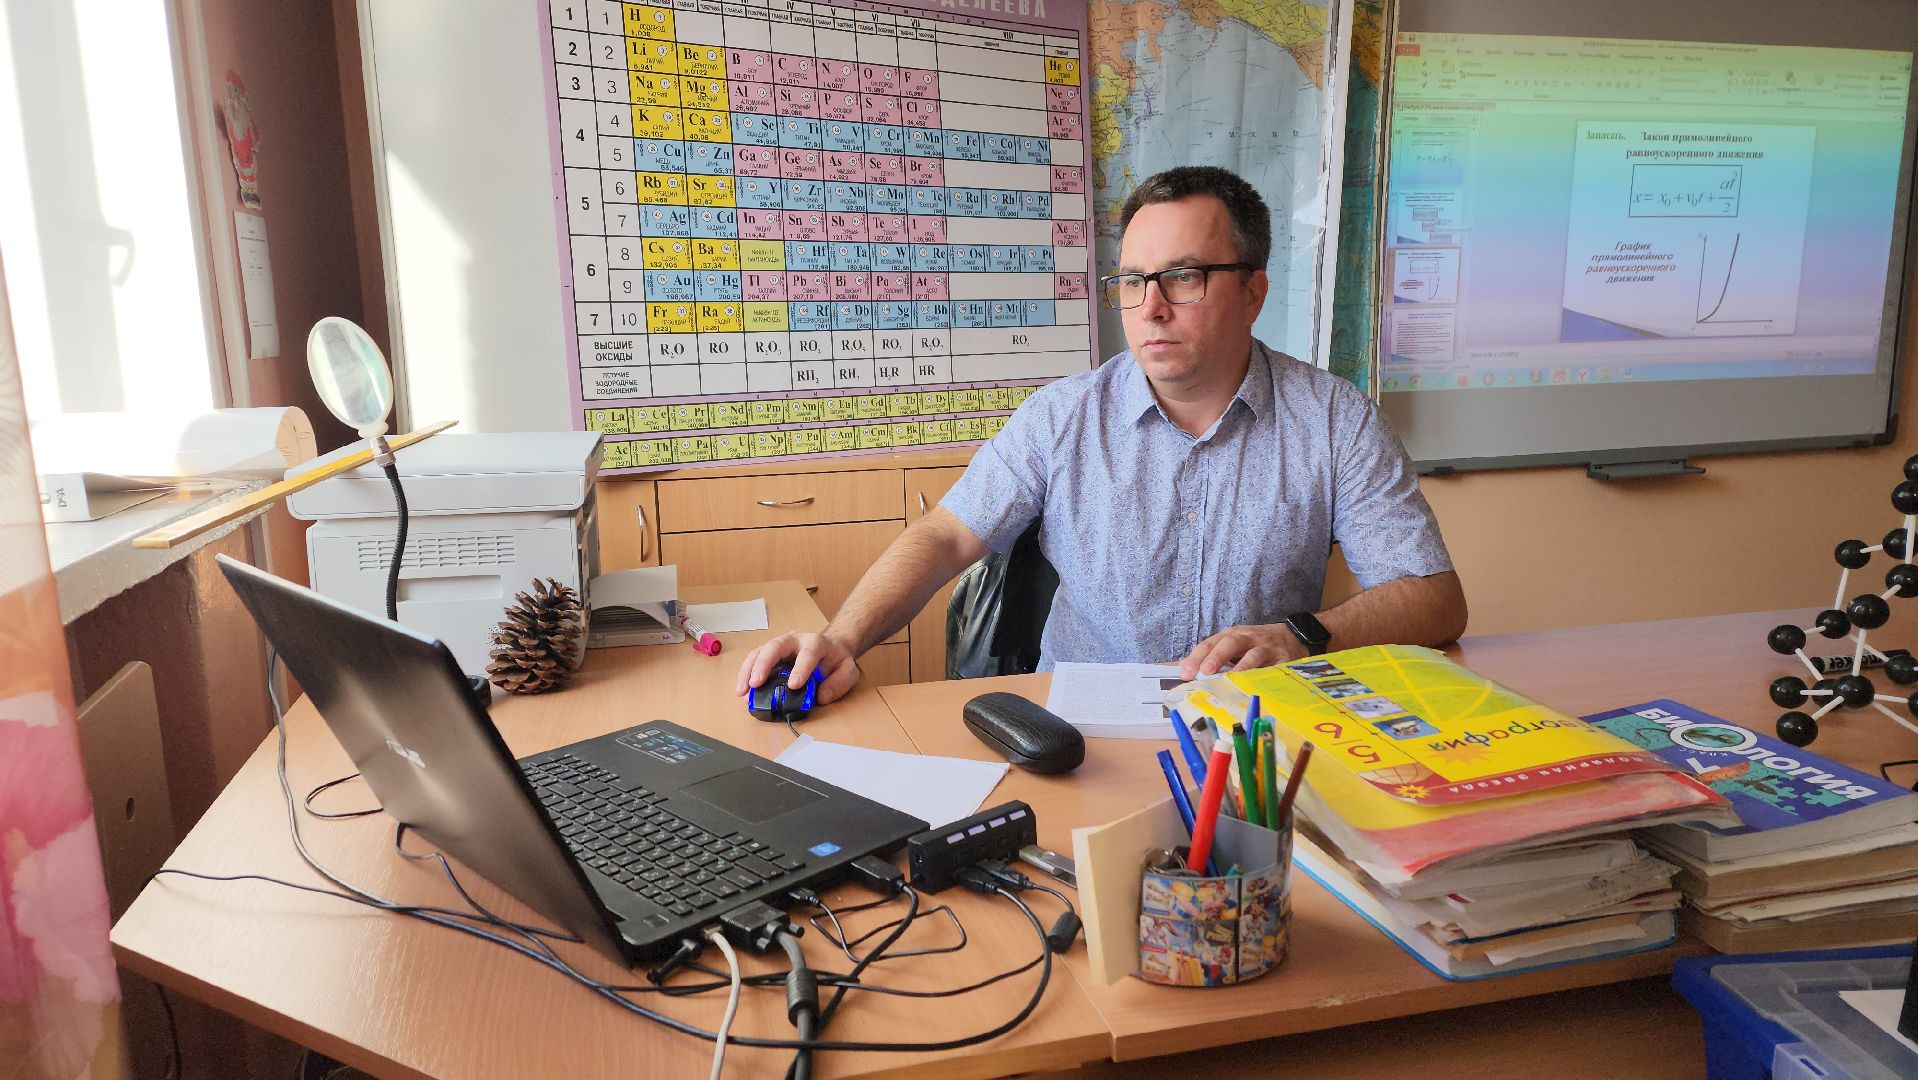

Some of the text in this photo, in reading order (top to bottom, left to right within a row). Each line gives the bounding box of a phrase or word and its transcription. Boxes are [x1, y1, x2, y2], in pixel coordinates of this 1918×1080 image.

[566, 7, 573, 20] 1
[603, 12, 609, 25] 1
[630, 8, 641, 21] H
[569, 42, 578, 56] 2
[605, 46, 614, 60] 2
[632, 42, 646, 56] Li
[683, 47, 699, 61] Be
[732, 53, 741, 65] B
[778, 57, 787, 70] C
[822, 62, 831, 75] N
[1049, 60, 1062, 71] He
[864, 68, 873, 79] O
[905, 71, 911, 82] F
[572, 76, 581, 91] 3
[608, 81, 617, 94] 3
[635, 75, 653, 90] Na
[686, 80, 706, 98] Mg
[735, 86, 748, 98] Al
[781, 89, 791, 101] Si
[1050, 88, 1063, 98] Ne
[824, 93, 831, 105] P
[866, 97, 873, 109] S
[906, 101, 918, 113] Cl
[611, 115, 620, 128] 4
[639, 109, 650, 122] K
[689, 113, 706, 126] Ca
[1052, 115, 1063, 126] Ar
[761, 119, 774, 130] Sc
[807, 122, 819, 134] Ti
[576, 129, 585, 142] 4
[852, 126, 860, 137] V
[887, 129, 901, 141] Cr
[923, 132, 940, 144] Mn
[966, 135, 978, 147] Fe
[1000, 137, 1013, 149] Co
[1641, 131, 1670, 142] Закон
[1672, 133, 1753, 145] прямолинейного
[613, 148, 622, 162] 5
[663, 144, 681, 157] Cu
[713, 147, 730, 160] Zn
[739, 149, 756, 161] Ga
[1626, 148, 1714, 160] равноускоренного
[785, 152, 800, 165] Ge
[829, 155, 842, 167] As
[869, 157, 881, 169] Se
[910, 160, 922, 172] Br
[1055, 169, 1067, 180] Kr
[615, 181, 625, 195] 6
[643, 176, 662, 189] Rb
[692, 178, 707, 190] Sr
[769, 182, 777, 194] Y
[808, 184, 822, 196] Zr
[849, 187, 863, 199] Nb
[887, 188, 904, 200] Mo
[931, 191, 943, 201] Tc
[581, 197, 590, 210] 5
[966, 192, 979, 204] Ru
[1002, 194, 1015, 204] Rh
[1038, 195, 1050, 206] Pd
[617, 215, 627, 228] 7
[669, 210, 686, 225] Ag
[716, 212, 734, 224] Cd
[743, 212, 756, 224] In
[788, 214, 803, 226] Sn
[831, 215, 845, 227] Sb
[873, 217, 885, 229] Te
[1056, 223, 1068, 233] Xe
[648, 242, 665, 254] Cs
[698, 243, 714, 255] Ba
[812, 246, 827, 257] Hf
[856, 246, 868, 258] Ta
[1615, 241, 1651, 251] График
[621, 248, 630, 261] 8
[895, 247, 907, 258] W
[933, 248, 946, 259] Re
[969, 248, 982, 259] Os
[1009, 249, 1018, 259] Ir
[1591, 252, 1673, 262] прямолинейного
[587, 263, 596, 277] 6
[1586, 264, 1676, 275] равноускоренного
[673, 275, 691, 286] Au
[721, 275, 738, 289] Hg
[748, 275, 760, 287] Tl
[792, 275, 807, 287] Pb
[835, 275, 846, 287] Bi
[876, 275, 889, 287] Po
[916, 276, 927, 287] At
[1059, 276, 1071, 286] Rn
[1605, 275, 1654, 284] движения
[623, 281, 632, 294] 9
[653, 306, 667, 317] Fr
[702, 306, 718, 317] Ra
[816, 304, 830, 316] Rf
[855, 304, 869, 316] Db
[897, 304, 909, 318] Sg
[934, 304, 948, 315] Bh
[590, 313, 599, 326] 7
[621, 313, 637, 326] 10
[594, 341, 633, 350] ВЫСШИЕ
[595, 352, 633, 362] ОКСИДЫ
[611, 411, 625, 422] La
[694, 407, 705, 418] Pr
[731, 405, 744, 416] Nd
[870, 427, 886, 437] Cm
[654, 442, 669, 453] Th
[696, 440, 709, 450] Pa
[739, 436, 747, 447] U
[614, 445, 628, 455] Ac
[1635, 707, 1877, 800] БИОЛОГИЯ
[1685, 757, 1721, 775] 7
